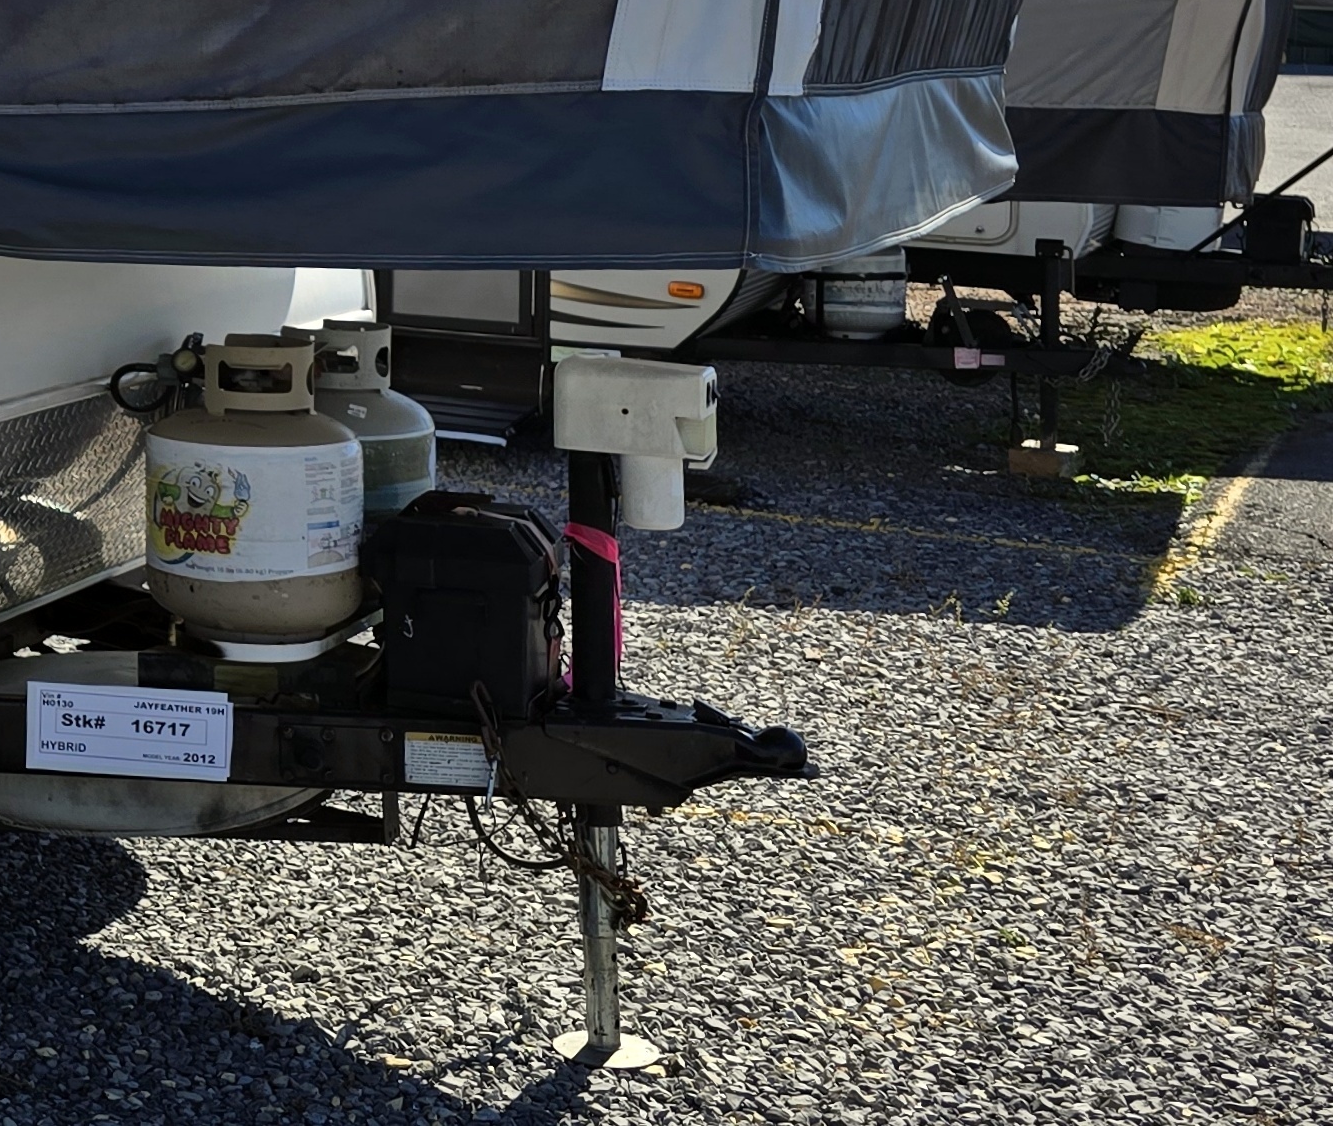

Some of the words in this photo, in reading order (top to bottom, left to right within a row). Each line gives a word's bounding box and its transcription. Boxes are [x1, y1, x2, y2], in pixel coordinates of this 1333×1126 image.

[160, 508, 239, 536] MIGHTY
[165, 527, 231, 554] FLAME
[133, 701, 202, 714] JAYFEATHER
[61, 713, 105, 729] Stk#
[131, 719, 190, 736] 16717
[435, 735, 478, 743] WARNING
[41, 740, 86, 752] HYBRID
[183, 753, 215, 764] 2012
